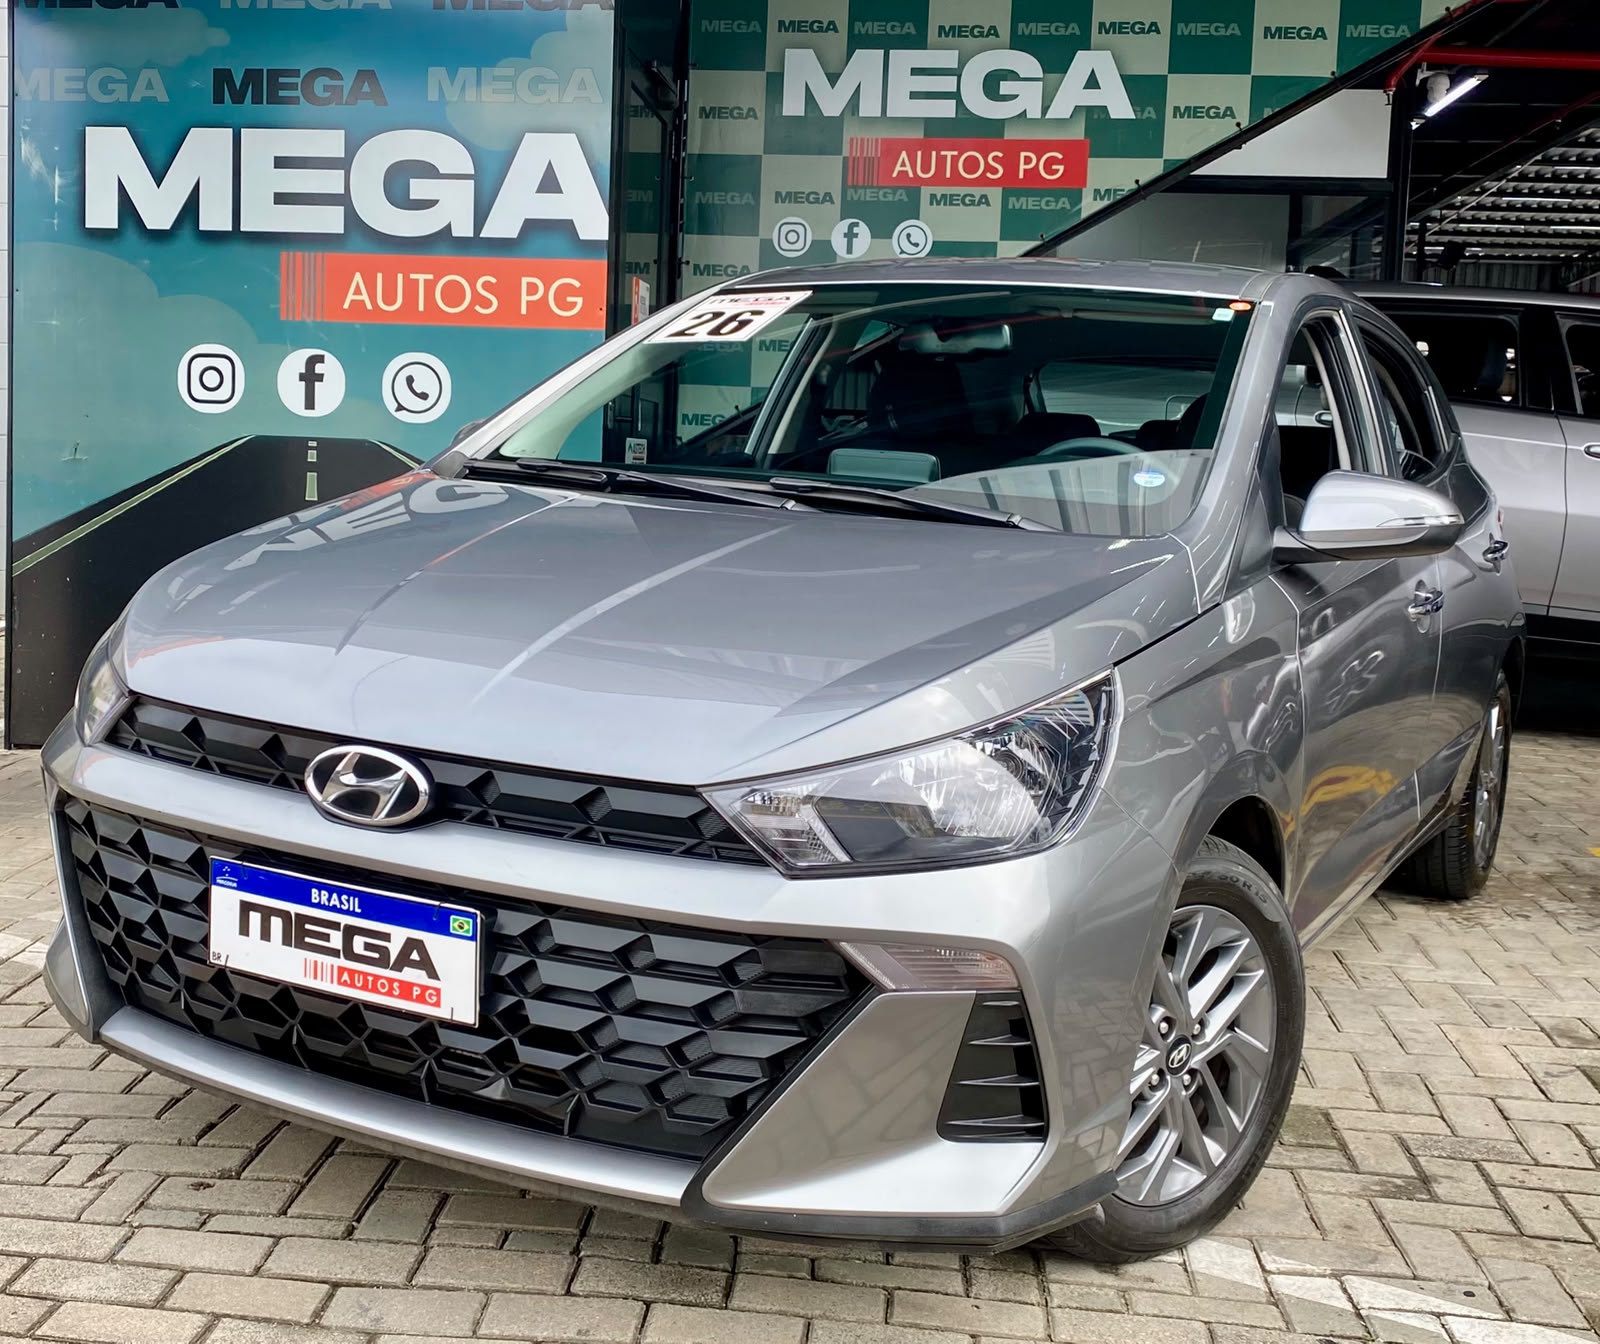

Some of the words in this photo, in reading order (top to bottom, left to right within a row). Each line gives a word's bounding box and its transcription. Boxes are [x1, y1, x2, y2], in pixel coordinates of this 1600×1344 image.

[701, 20, 762, 33] MEGA
[777, 20, 839, 33] MEGA
[854, 22, 916, 35] MEGA
[937, 25, 1000, 39] MEGA
[1018, 22, 1081, 36] MEGA
[1098, 21, 1161, 35] MEGA
[1177, 23, 1241, 36] MEGA
[1263, 26, 1328, 40] MEGA
[1345, 25, 1411, 38] MEGA
[14, 67, 170, 103] MEGA
[212, 67, 389, 106] MEGA
[427, 66, 604, 104] MEGA
[782, 48, 1136, 119] MEGA
[698, 106, 759, 120] MEGA
[1172, 105, 1237, 119] MEGA
[892, 151, 1004, 180] AUTOS
[1018, 151, 1065, 180] PG
[85, 126, 609, 240] MEGA
[695, 191, 755, 205] MEGA
[774, 191, 836, 205] MEGA
[847, 188, 909, 202] MEGA
[929, 193, 991, 207] MEGA
[1008, 197, 1071, 210] MEGA
[343, 272, 498, 315] AUTOS
[520, 277, 583, 317] PG
[665, 310, 765, 338] 26
[681, 413, 727, 426] MEG
[311, 888, 362, 913] BRASIL
[238, 899, 441, 981] MEGA
[211, 951, 222, 962] BR
[340, 971, 400, 996] AUTOS
[412, 987, 438, 1004] PG
